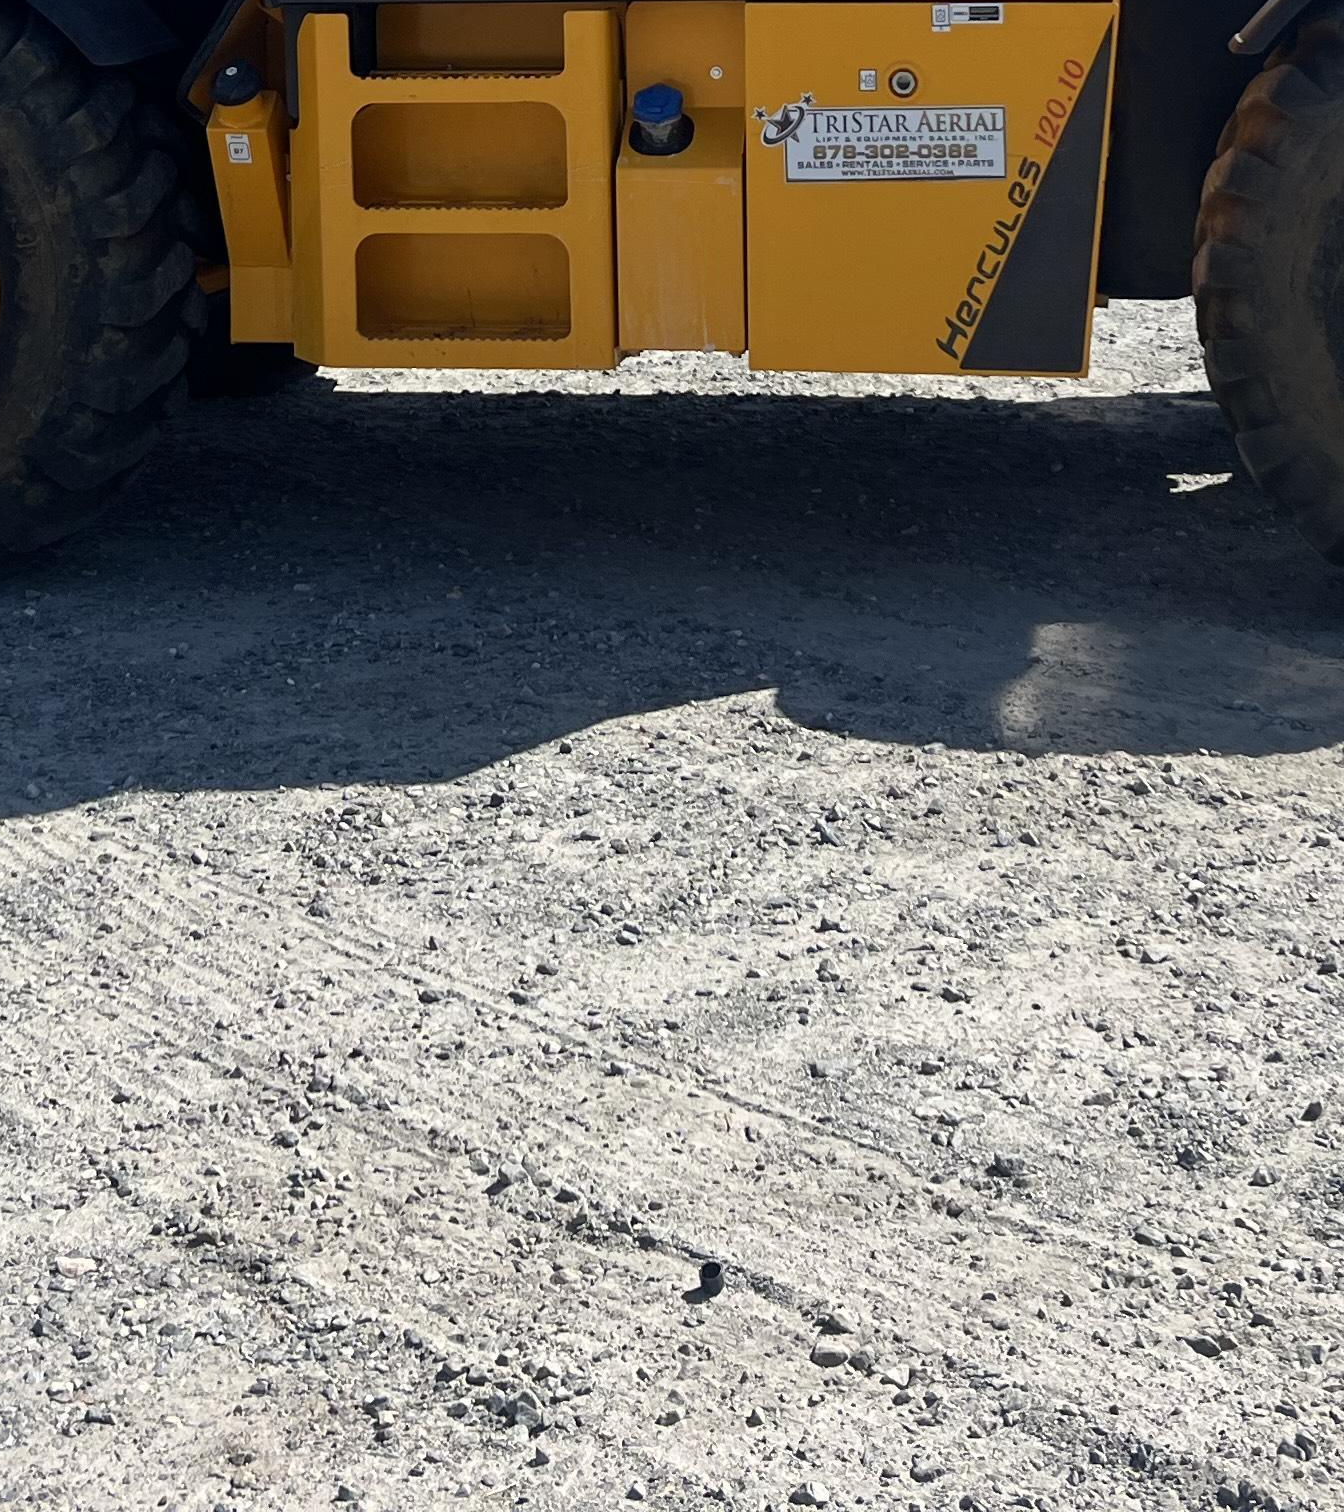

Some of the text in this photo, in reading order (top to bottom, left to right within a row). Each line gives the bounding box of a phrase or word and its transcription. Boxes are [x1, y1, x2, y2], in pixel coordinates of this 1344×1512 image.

[1034, 58, 1085, 148] 120.10
[797, 159, 994, 169] SALES RENTALS SERVICE PARTS
